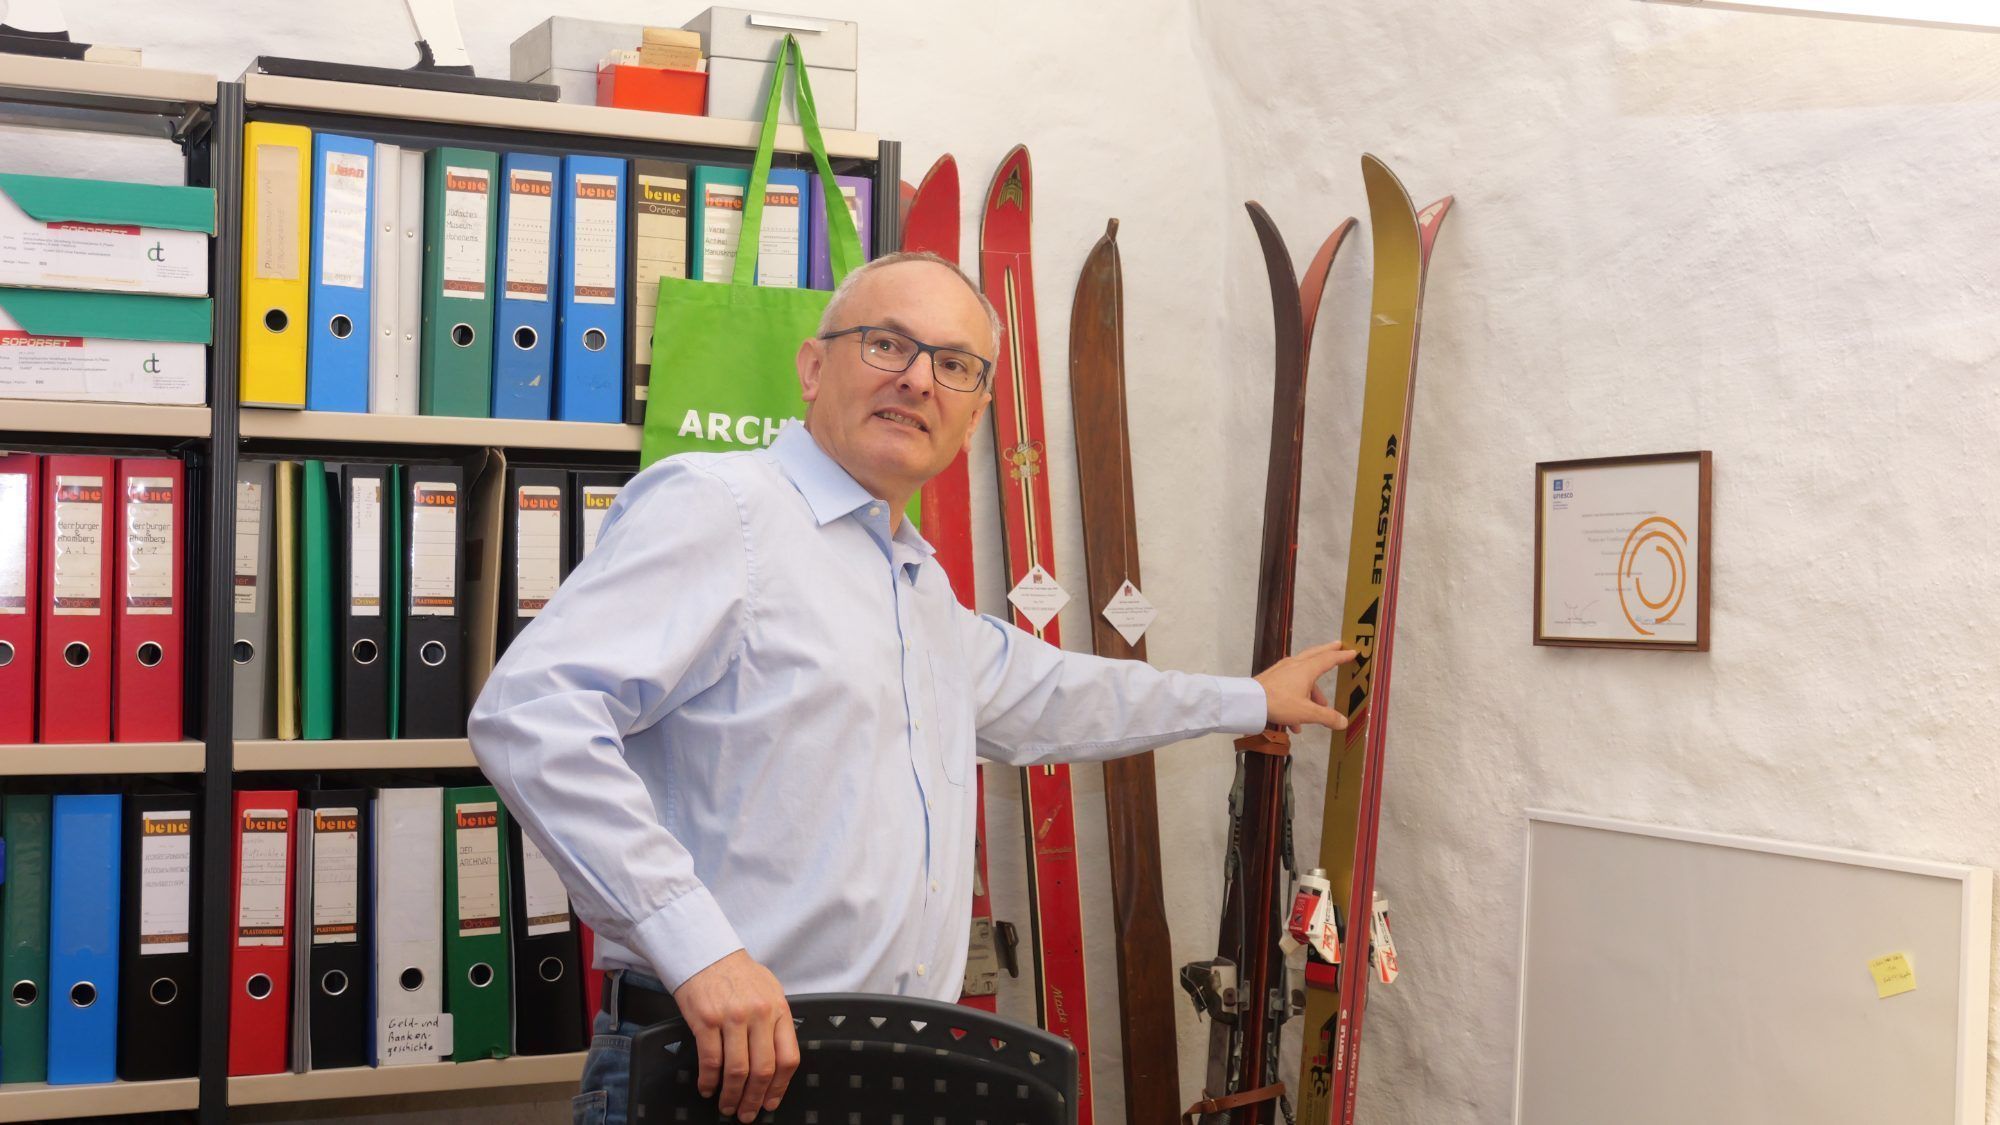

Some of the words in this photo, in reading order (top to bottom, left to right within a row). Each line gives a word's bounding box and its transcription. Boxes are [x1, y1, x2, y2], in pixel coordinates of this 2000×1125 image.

[447, 171, 487, 191] bene
[511, 174, 551, 194] bene
[576, 179, 616, 198] bene
[644, 178, 681, 203] bene
[705, 189, 743, 209] bene
[649, 204, 681, 216] Ordner
[579, 287, 609, 297] Ordner
[416, 485, 456, 505] bene
[519, 490, 559, 508] bene
[144, 816, 189, 834] bene
[246, 812, 288, 831] bene
[316, 811, 357, 831] bene
[457, 808, 497, 827] bene
